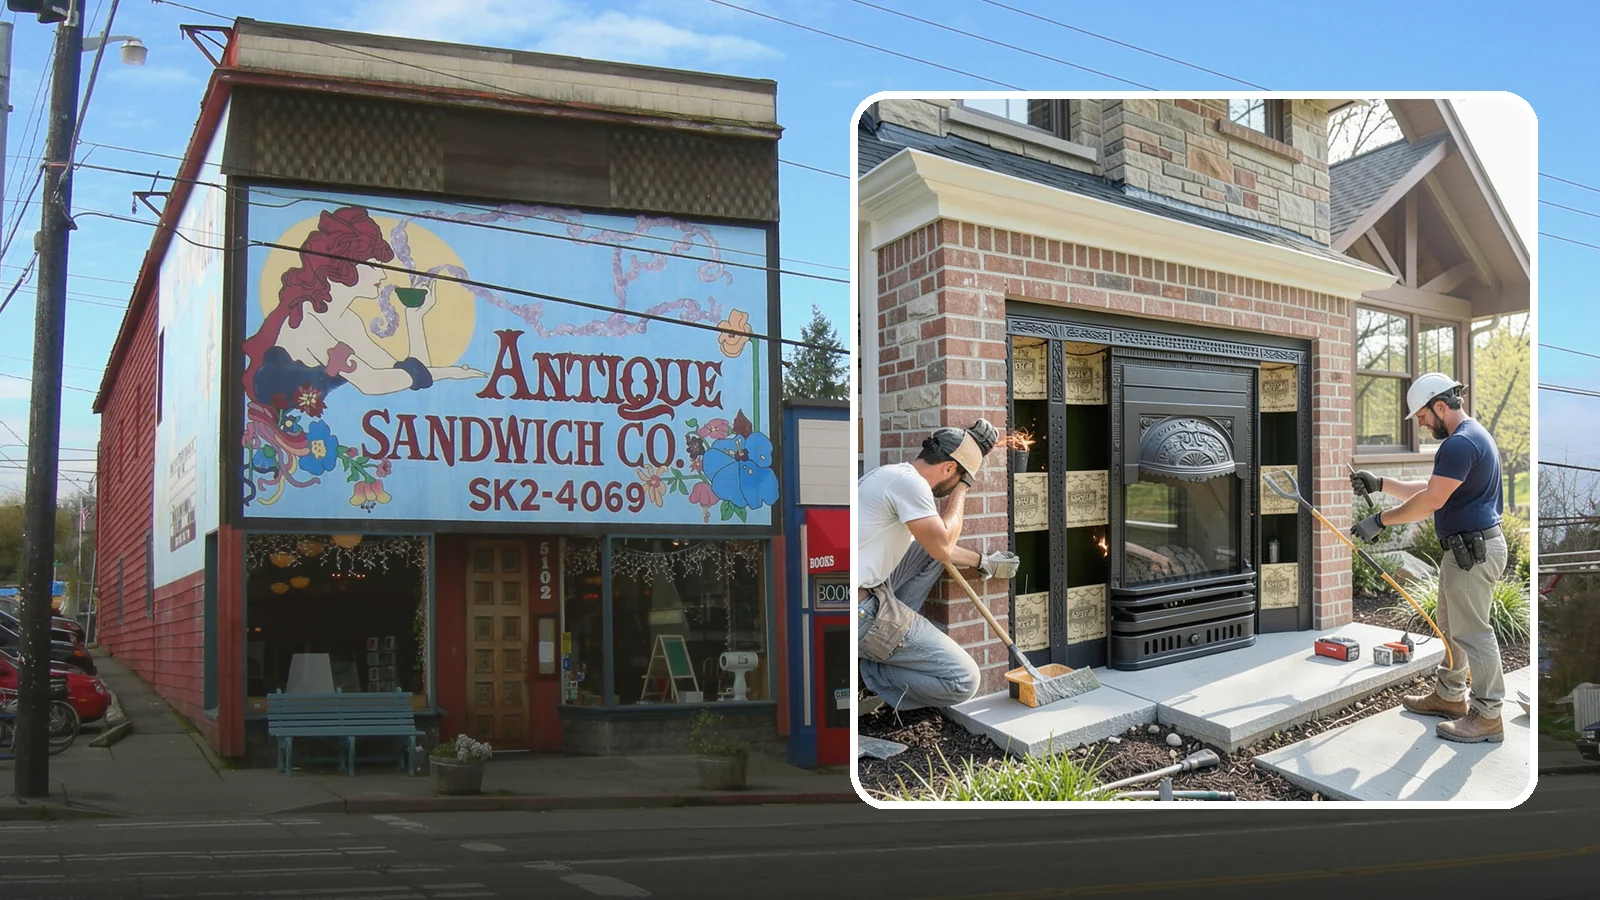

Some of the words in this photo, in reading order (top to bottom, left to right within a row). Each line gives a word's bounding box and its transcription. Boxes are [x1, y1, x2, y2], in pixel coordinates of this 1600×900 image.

[476, 329, 723, 420] ANTIQUE
[361, 408, 604, 468] SANDWICH
[617, 421, 685, 469] CO.
[468, 478, 645, 514] SK2-4069
[539, 541, 552, 600] 5102
[809, 555, 835, 569] BOOKS
